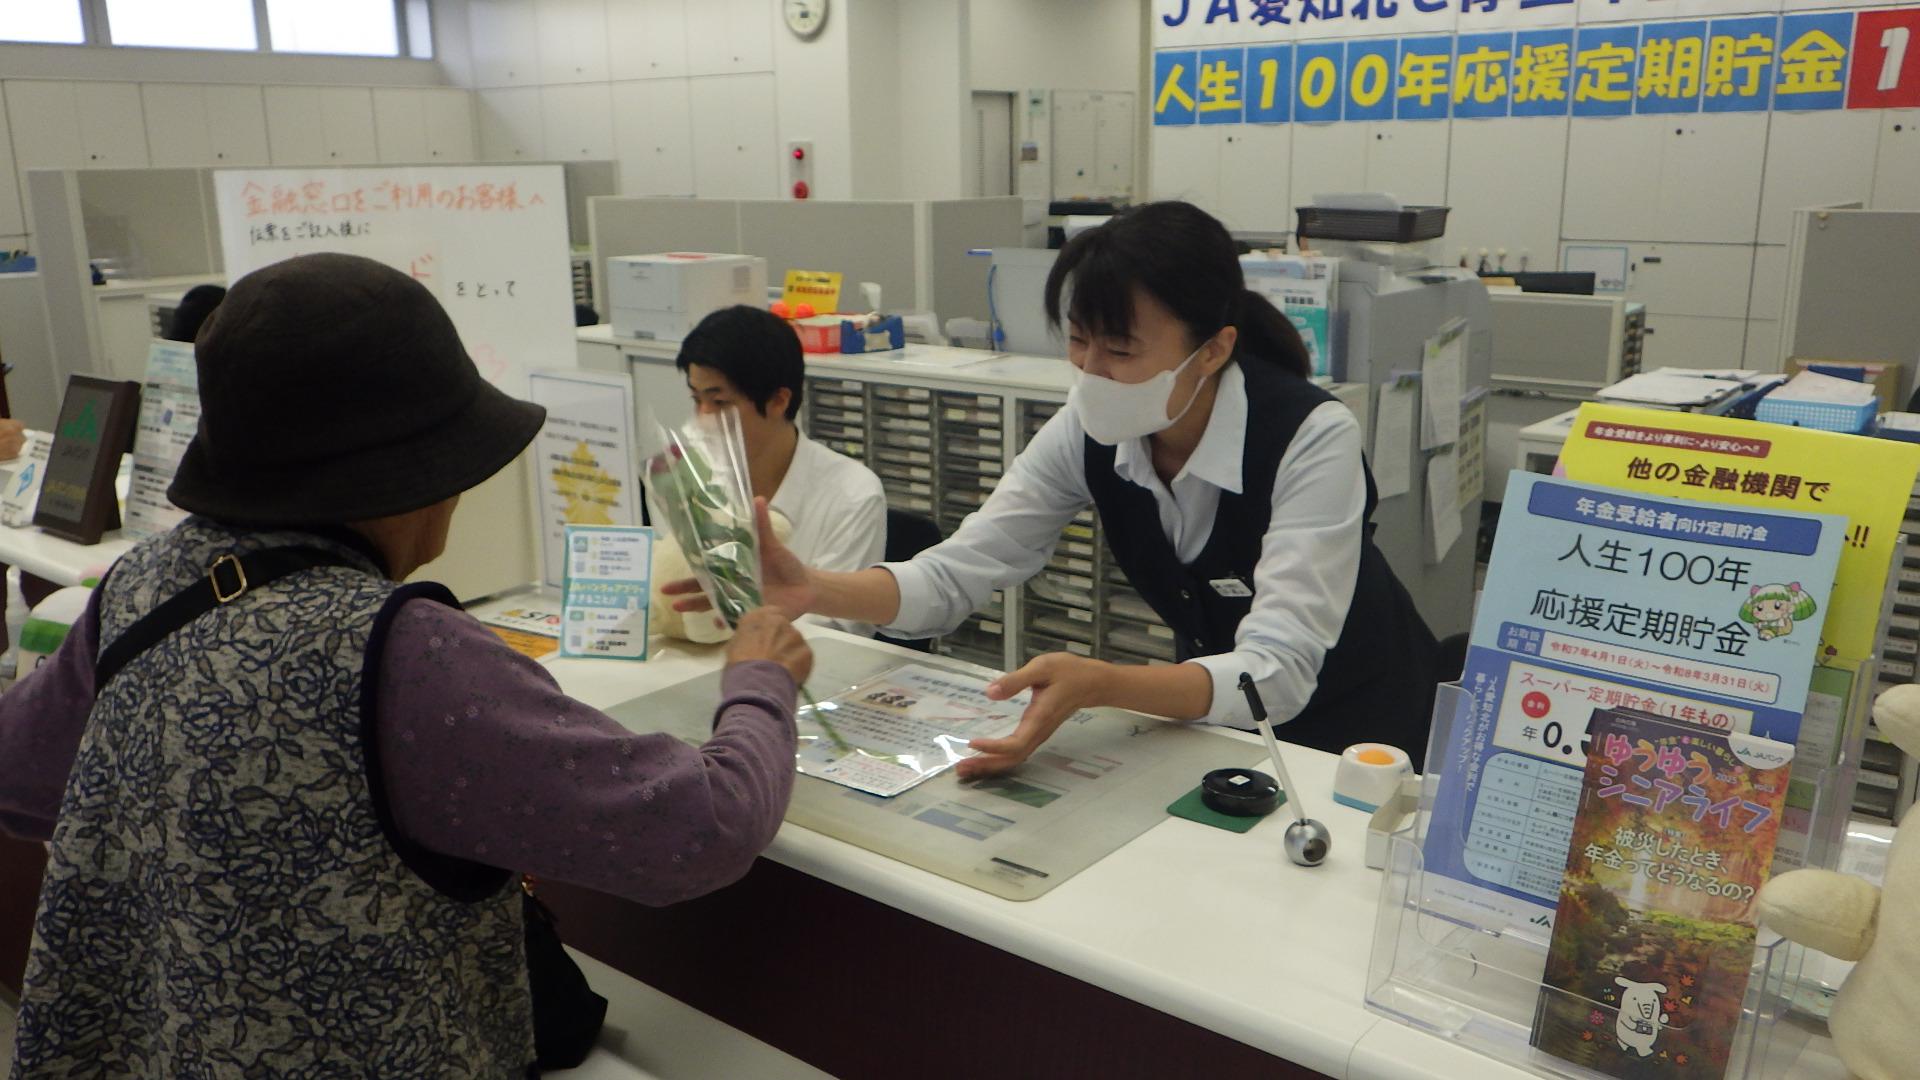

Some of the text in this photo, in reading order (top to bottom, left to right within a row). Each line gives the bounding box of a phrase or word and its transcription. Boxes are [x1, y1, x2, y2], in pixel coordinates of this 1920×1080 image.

[1155, 29, 1847, 113] 人生100年応援定期貯金
[1627, 456, 1831, 502] 他の金融機関で
[1576, 497, 1768, 543] 年金受給者向け定期貯金
[1557, 533, 1752, 591] 人生100年
[1529, 588, 1751, 657] 応援定期貯金
[1522, 725, 1538, 741] 年
[1604, 732, 1713, 785] ゆうゆう
[1597, 765, 1773, 834] シニアライフ
[1583, 842, 1756, 904] 年金ってどうなるの?
[1614, 826, 1729, 874] 被災したとき、
